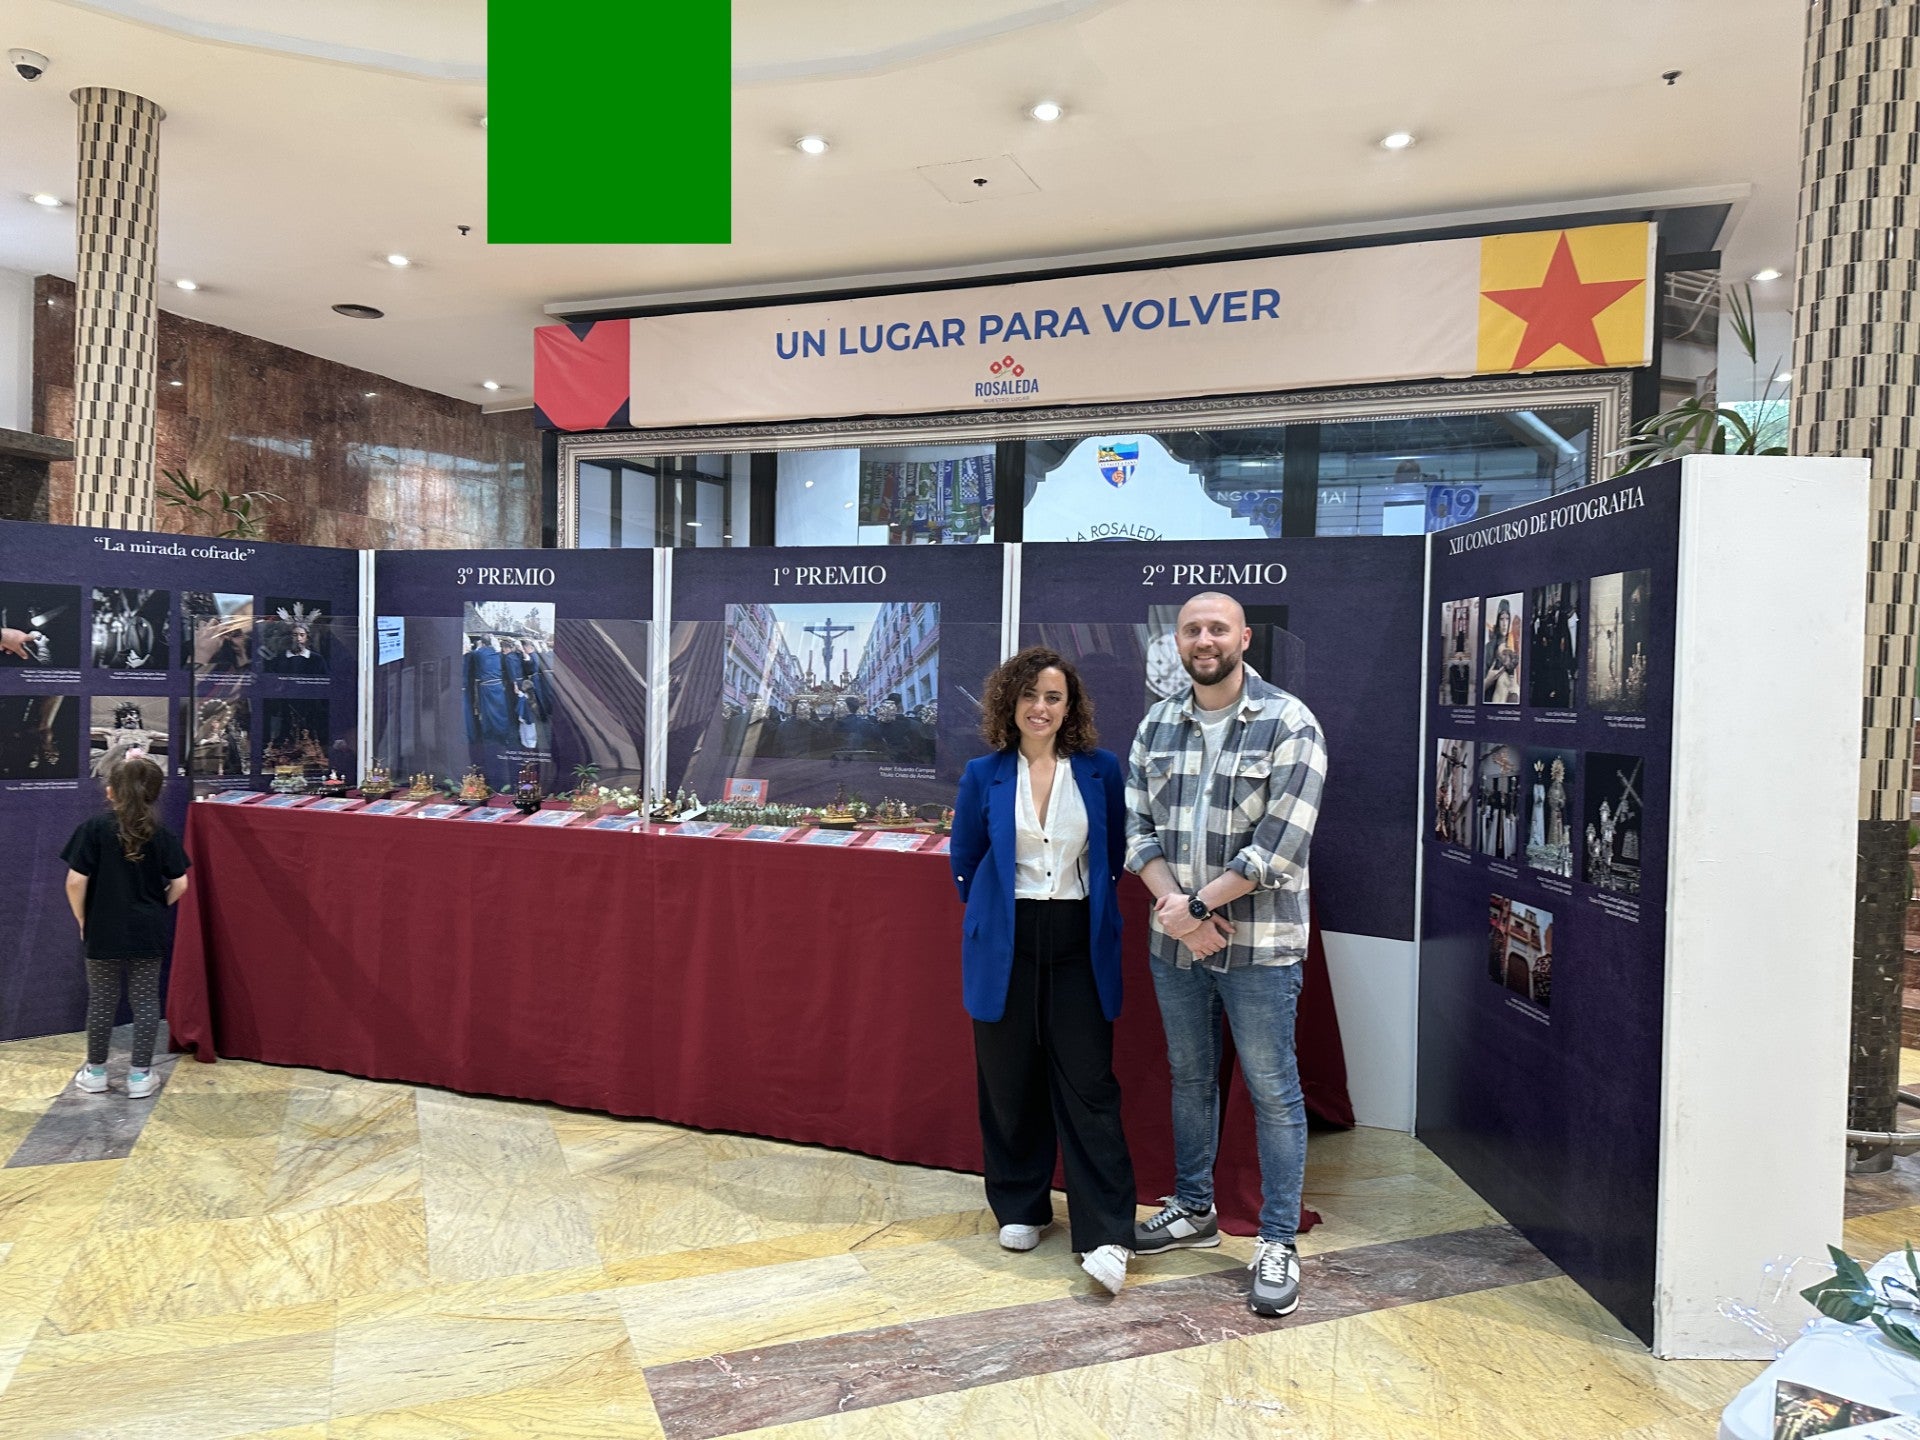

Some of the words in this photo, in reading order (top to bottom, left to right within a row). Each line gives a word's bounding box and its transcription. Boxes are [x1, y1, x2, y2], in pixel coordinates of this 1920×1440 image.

[776, 329, 826, 360] UN
[839, 318, 966, 355] LUGAR
[979, 306, 1090, 344] PARA
[1101, 288, 1281, 333] VOLVER
[975, 379, 1039, 397] ROSALEDA
[1449, 536, 1464, 556] XII
[1465, 518, 1528, 551] CONCURSO
[1529, 512, 1548, 536] DE
[1549, 486, 1646, 530] FOTOGRAFIA
[130, 540, 187, 556] mirada
[477, 567, 556, 586] PREMIO
[794, 565, 887, 586] PREMIO
[1170, 563, 1288, 585] PREMIO
